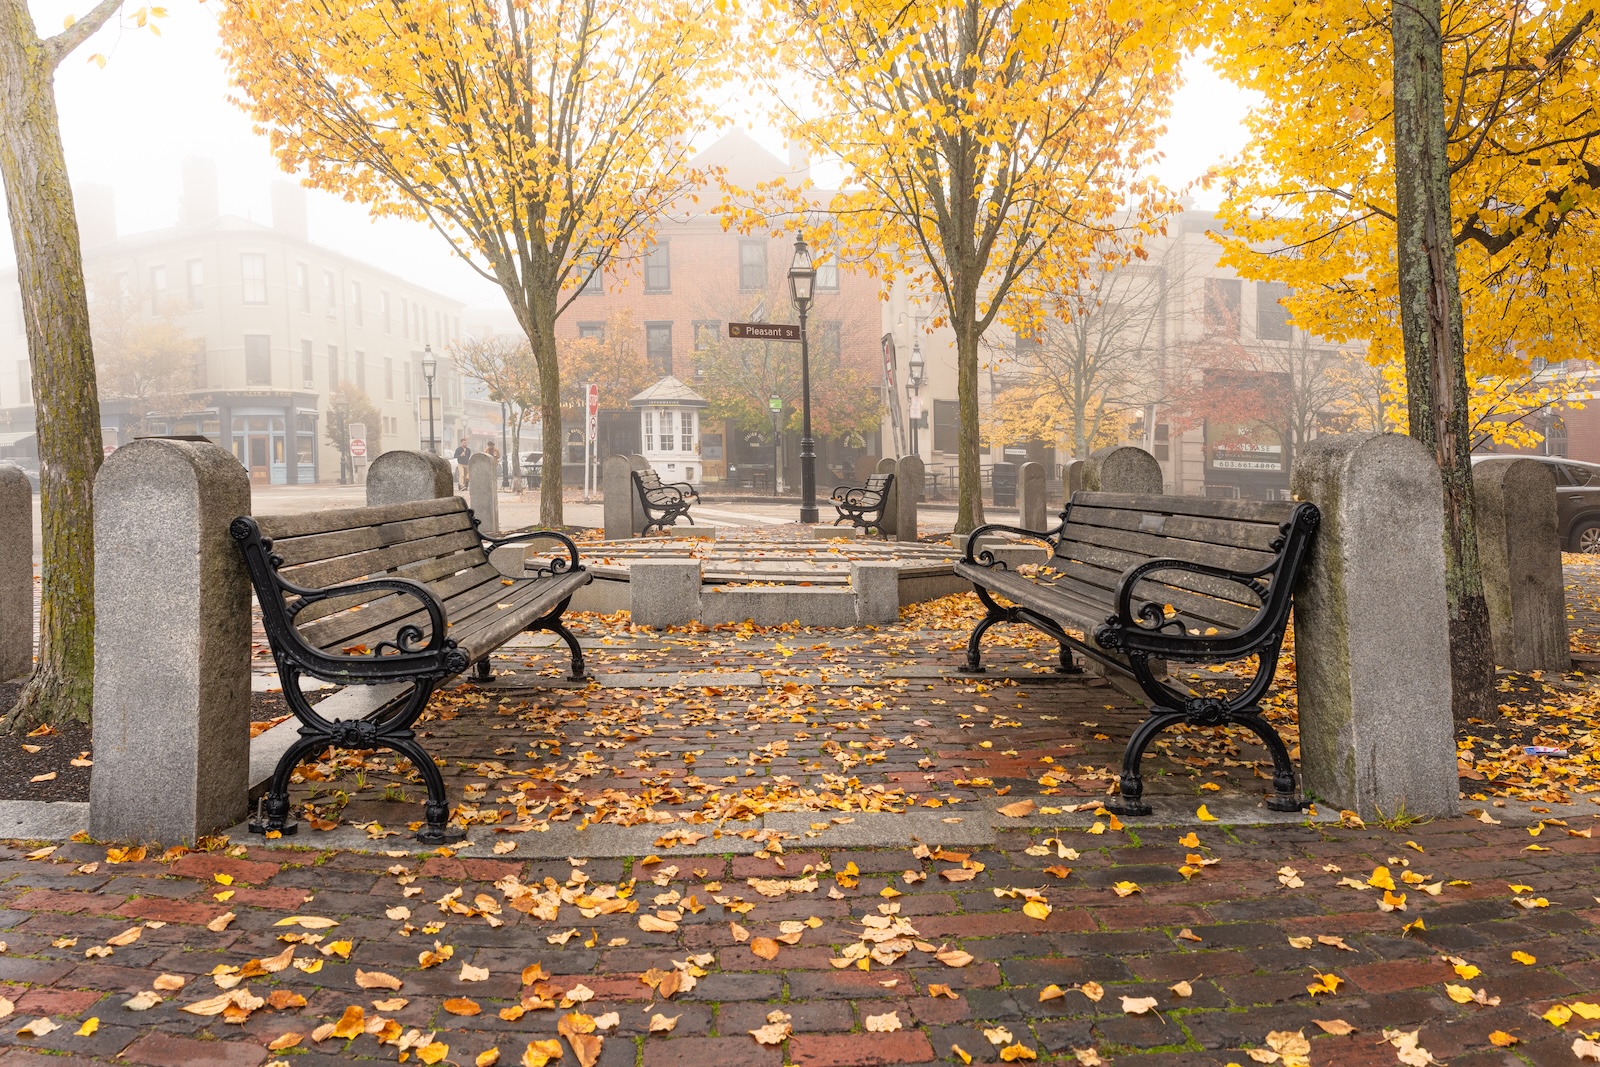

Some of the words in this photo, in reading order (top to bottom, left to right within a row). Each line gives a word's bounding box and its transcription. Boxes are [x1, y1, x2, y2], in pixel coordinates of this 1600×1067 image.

[746, 326, 782, 336] Pleasant
[786, 329, 793, 337] St
[1244, 444, 1271, 452] LASE
